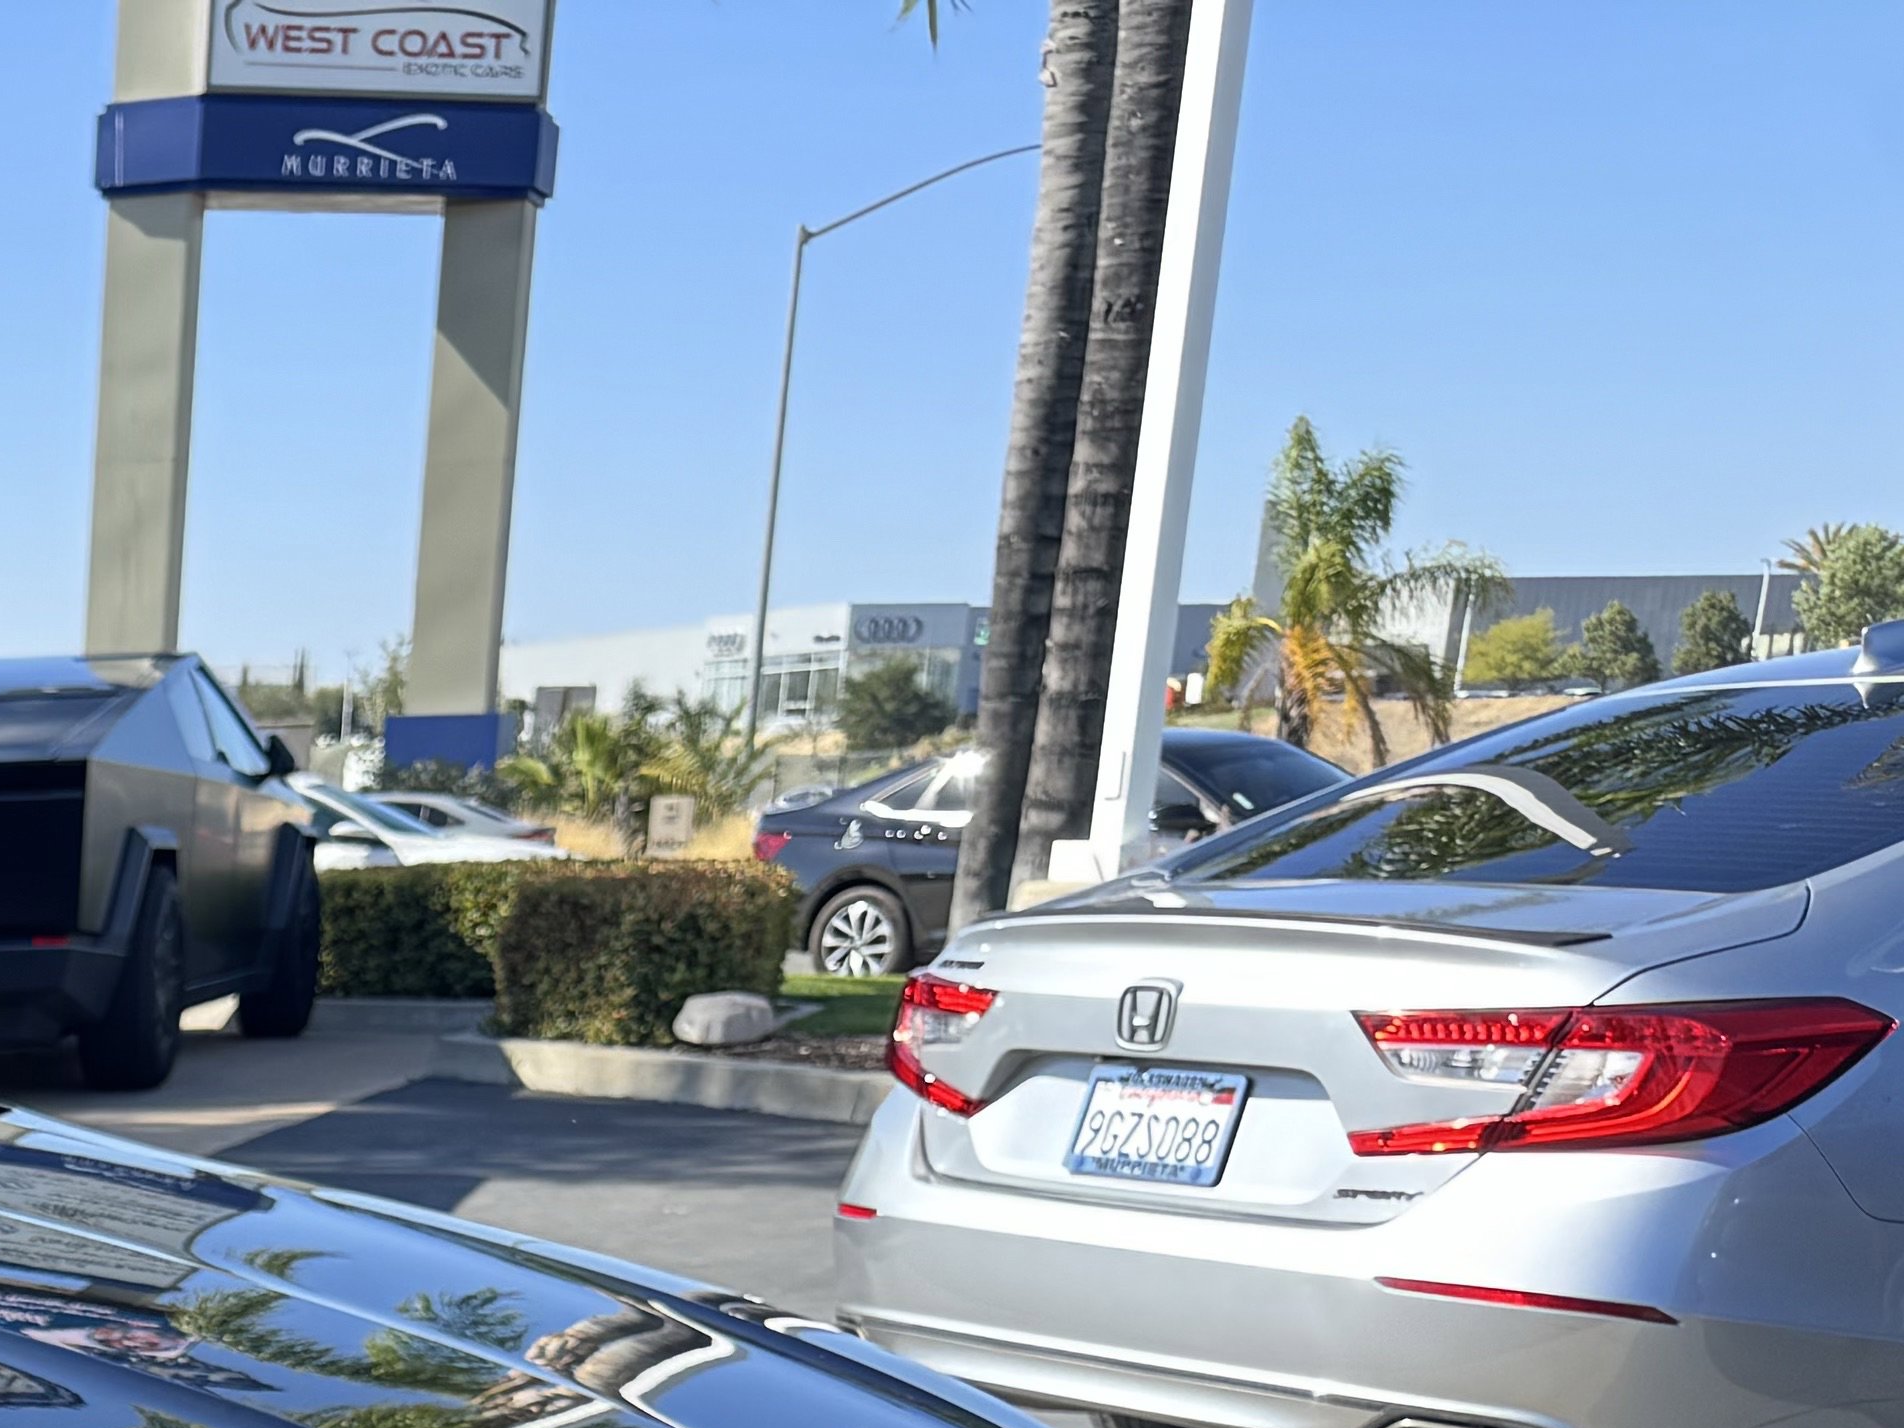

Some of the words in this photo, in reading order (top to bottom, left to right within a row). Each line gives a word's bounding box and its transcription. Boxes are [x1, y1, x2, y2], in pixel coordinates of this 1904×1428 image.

[244, 23, 359, 55] WEST
[371, 28, 513, 60] COAST
[281, 154, 457, 181] MURRIETA
[1080, 1110, 1220, 1165] 9GZS088
